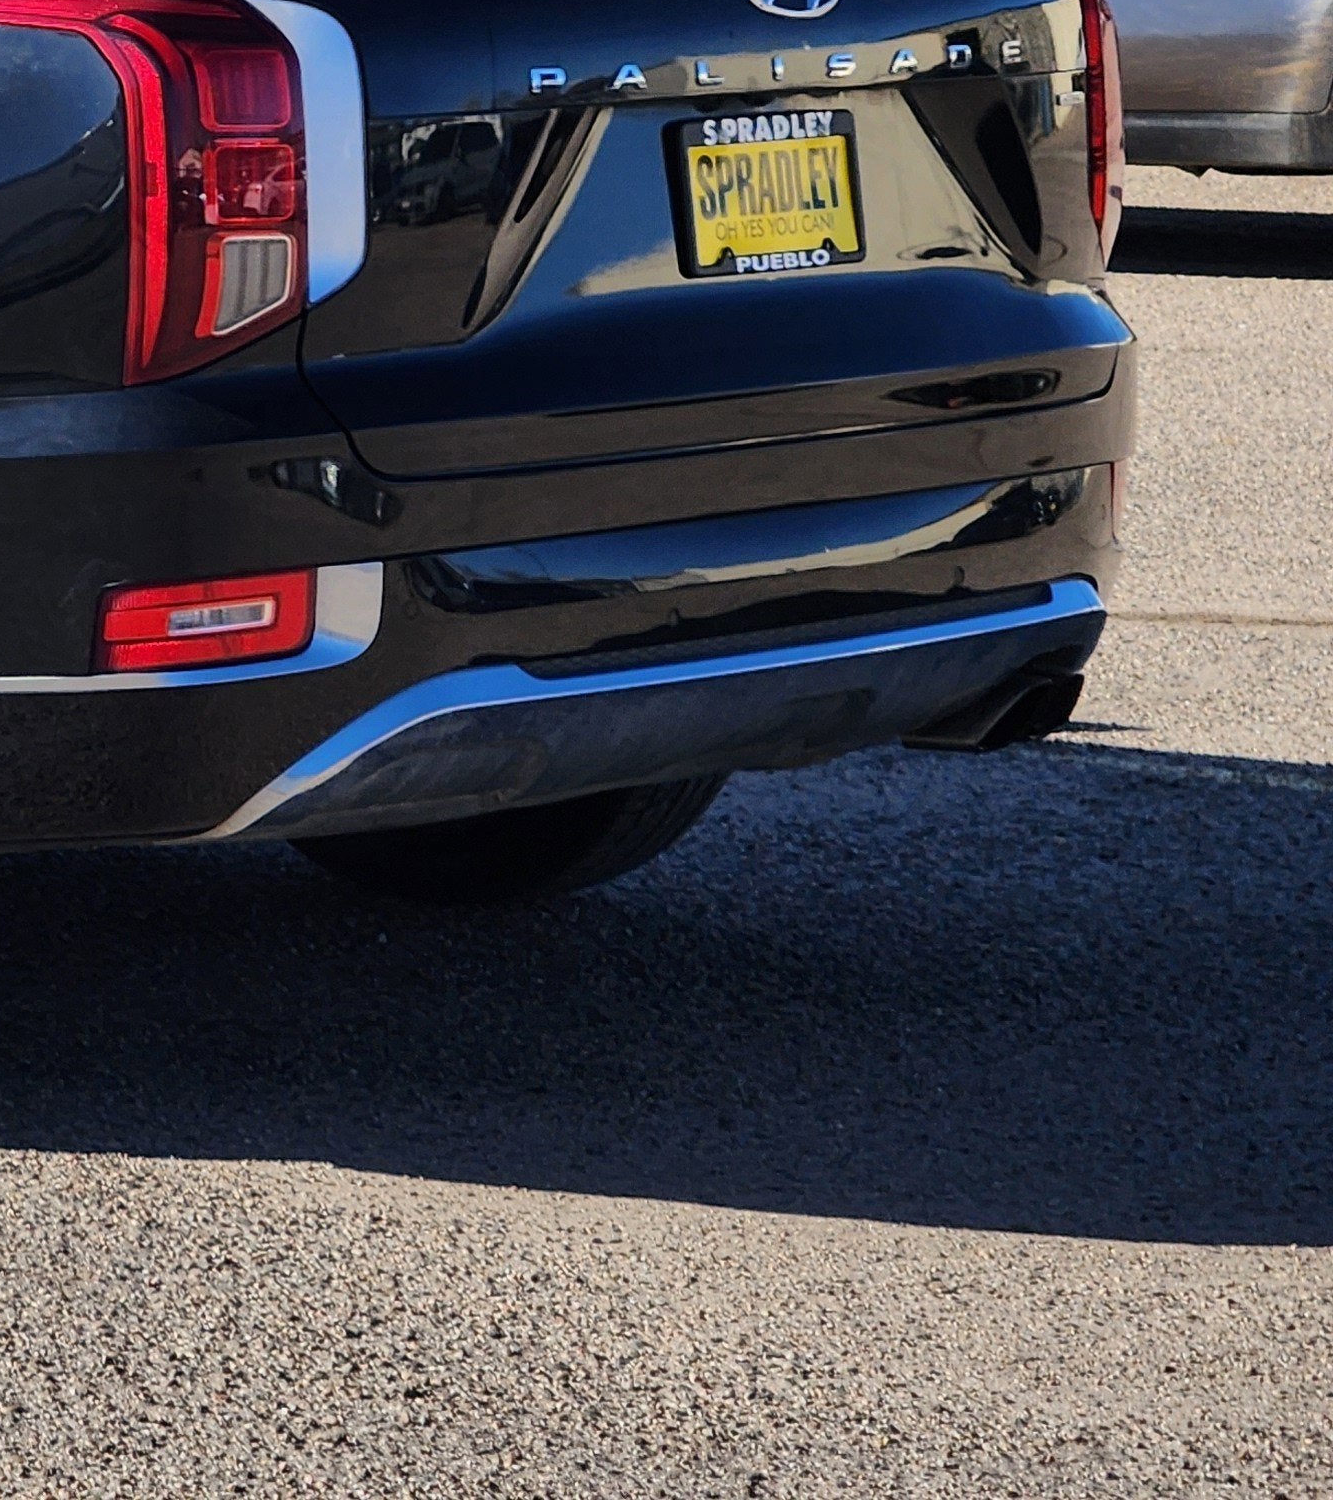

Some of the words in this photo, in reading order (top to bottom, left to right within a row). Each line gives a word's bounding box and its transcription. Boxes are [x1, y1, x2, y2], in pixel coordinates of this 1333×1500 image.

[529, 39, 1023, 94] PALISADE
[702, 110, 834, 146] SPRADLEY
[696, 146, 840, 221] SPRADLEY
[715, 220, 738, 241] OH
[741, 217, 765, 238] YES
[767, 215, 798, 238] YOU
[735, 249, 831, 274] PUEBLO
